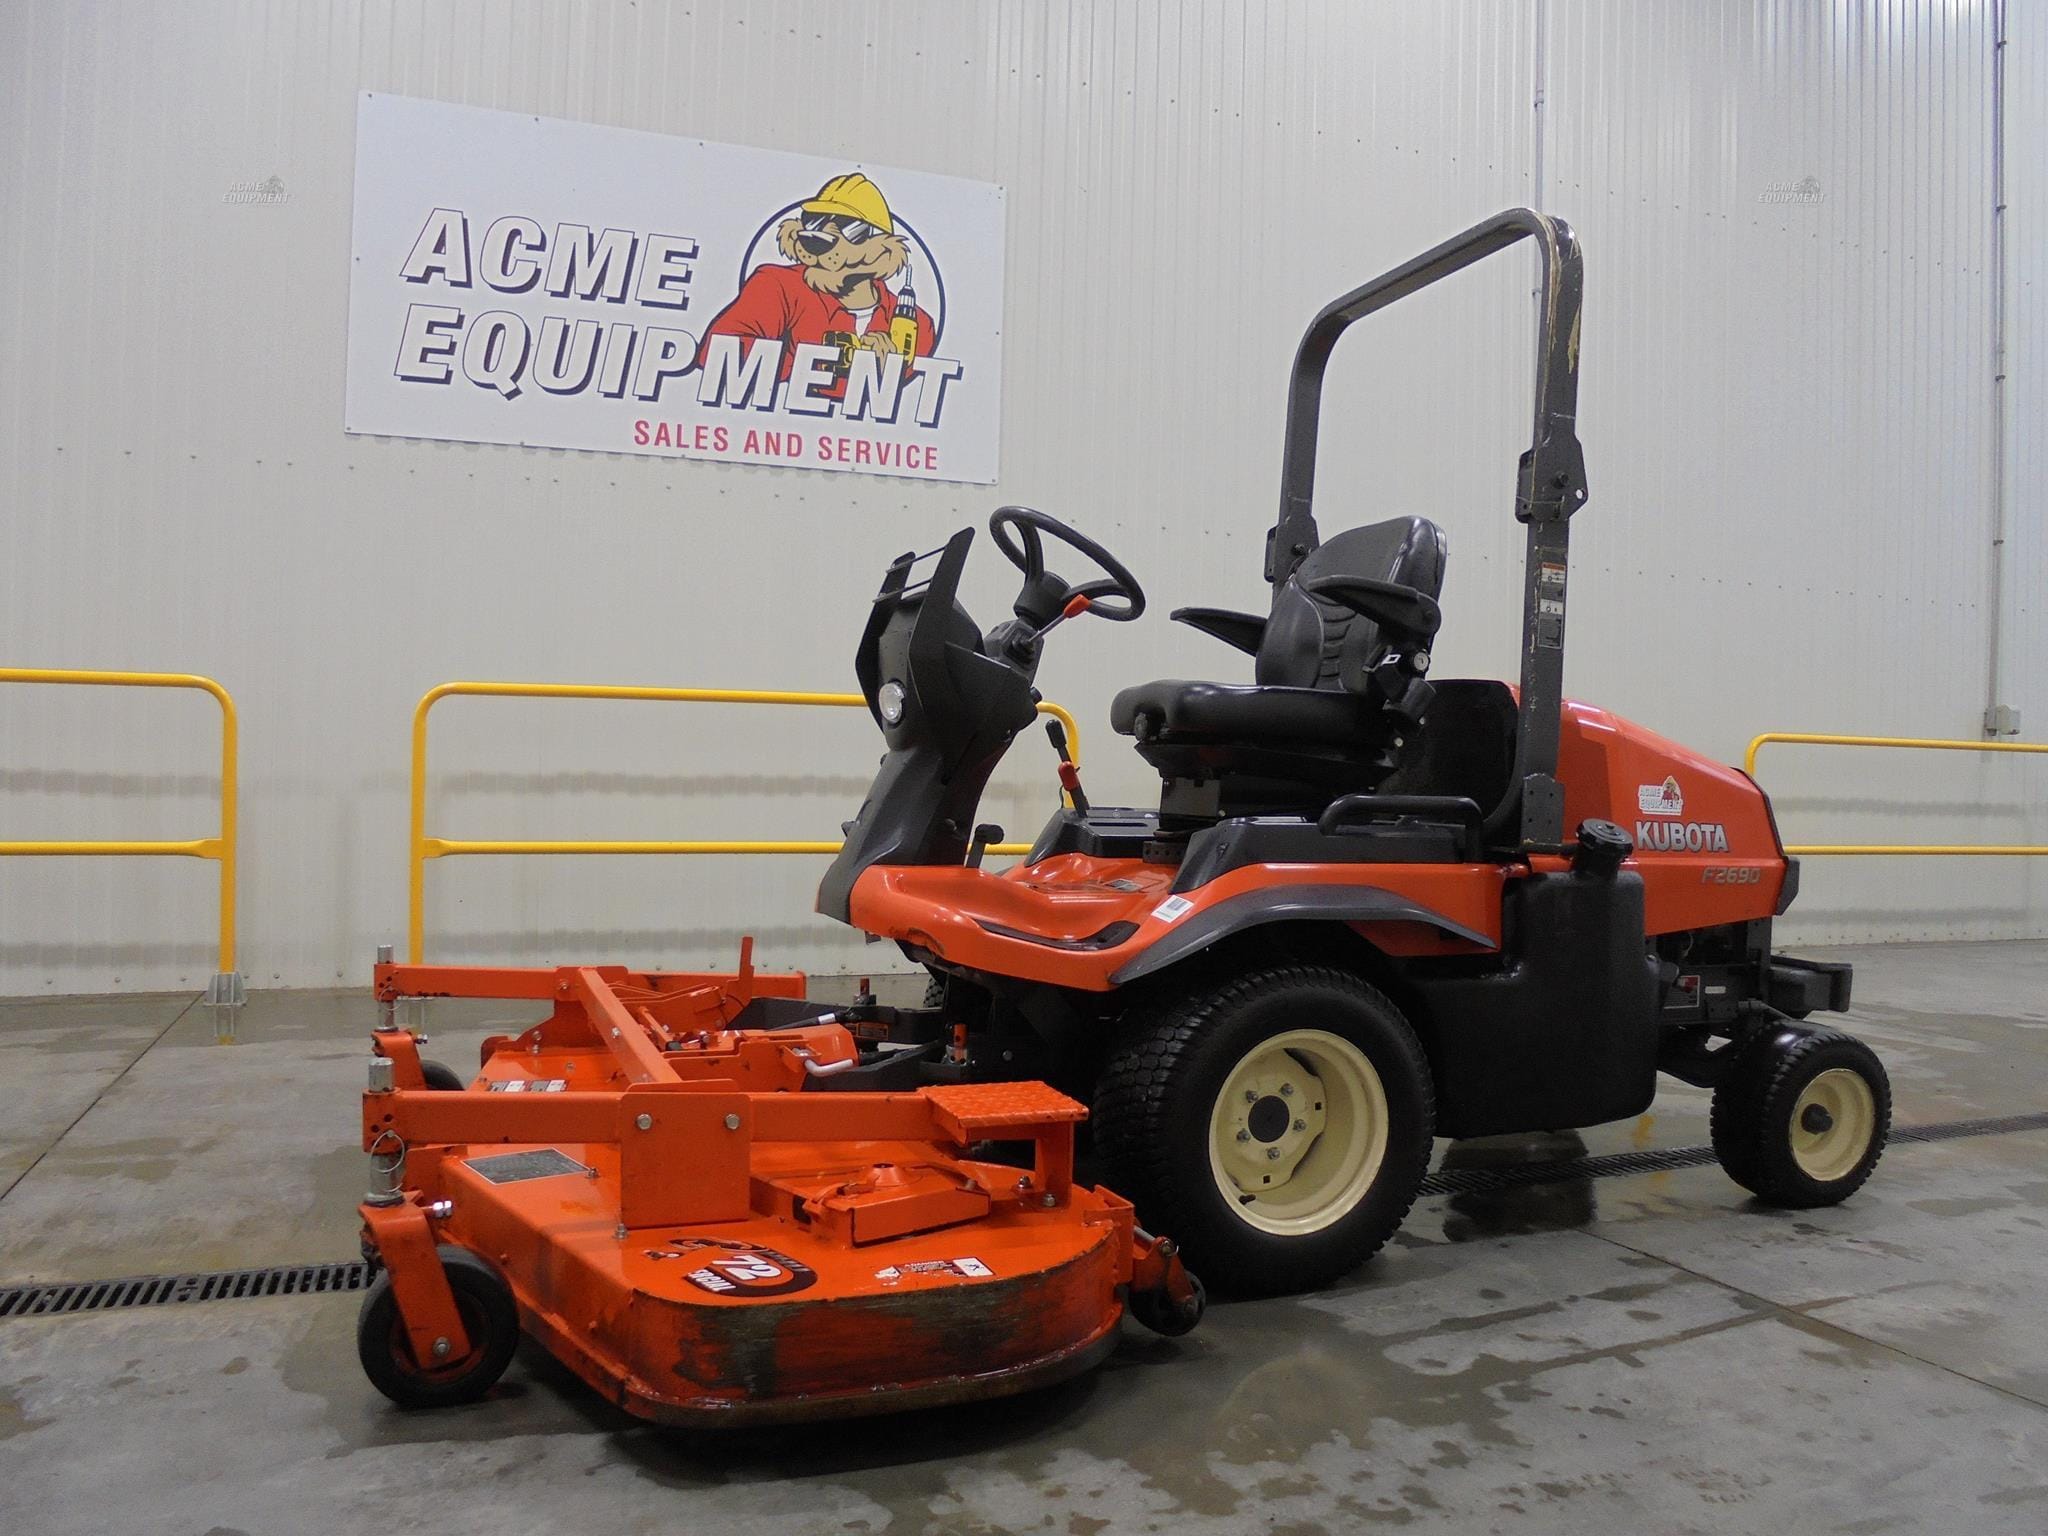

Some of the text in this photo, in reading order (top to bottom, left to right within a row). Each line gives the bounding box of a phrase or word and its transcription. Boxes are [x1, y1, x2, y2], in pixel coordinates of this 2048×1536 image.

[399, 207, 700, 311] ACME
[394, 303, 964, 429] EQUIPMENT
[634, 420, 938, 470] SALES AND SERVICE
[1635, 821, 1729, 852] KUBOTA
[1702, 866, 1761, 885] F2690
[711, 1255, 782, 1281] 72
